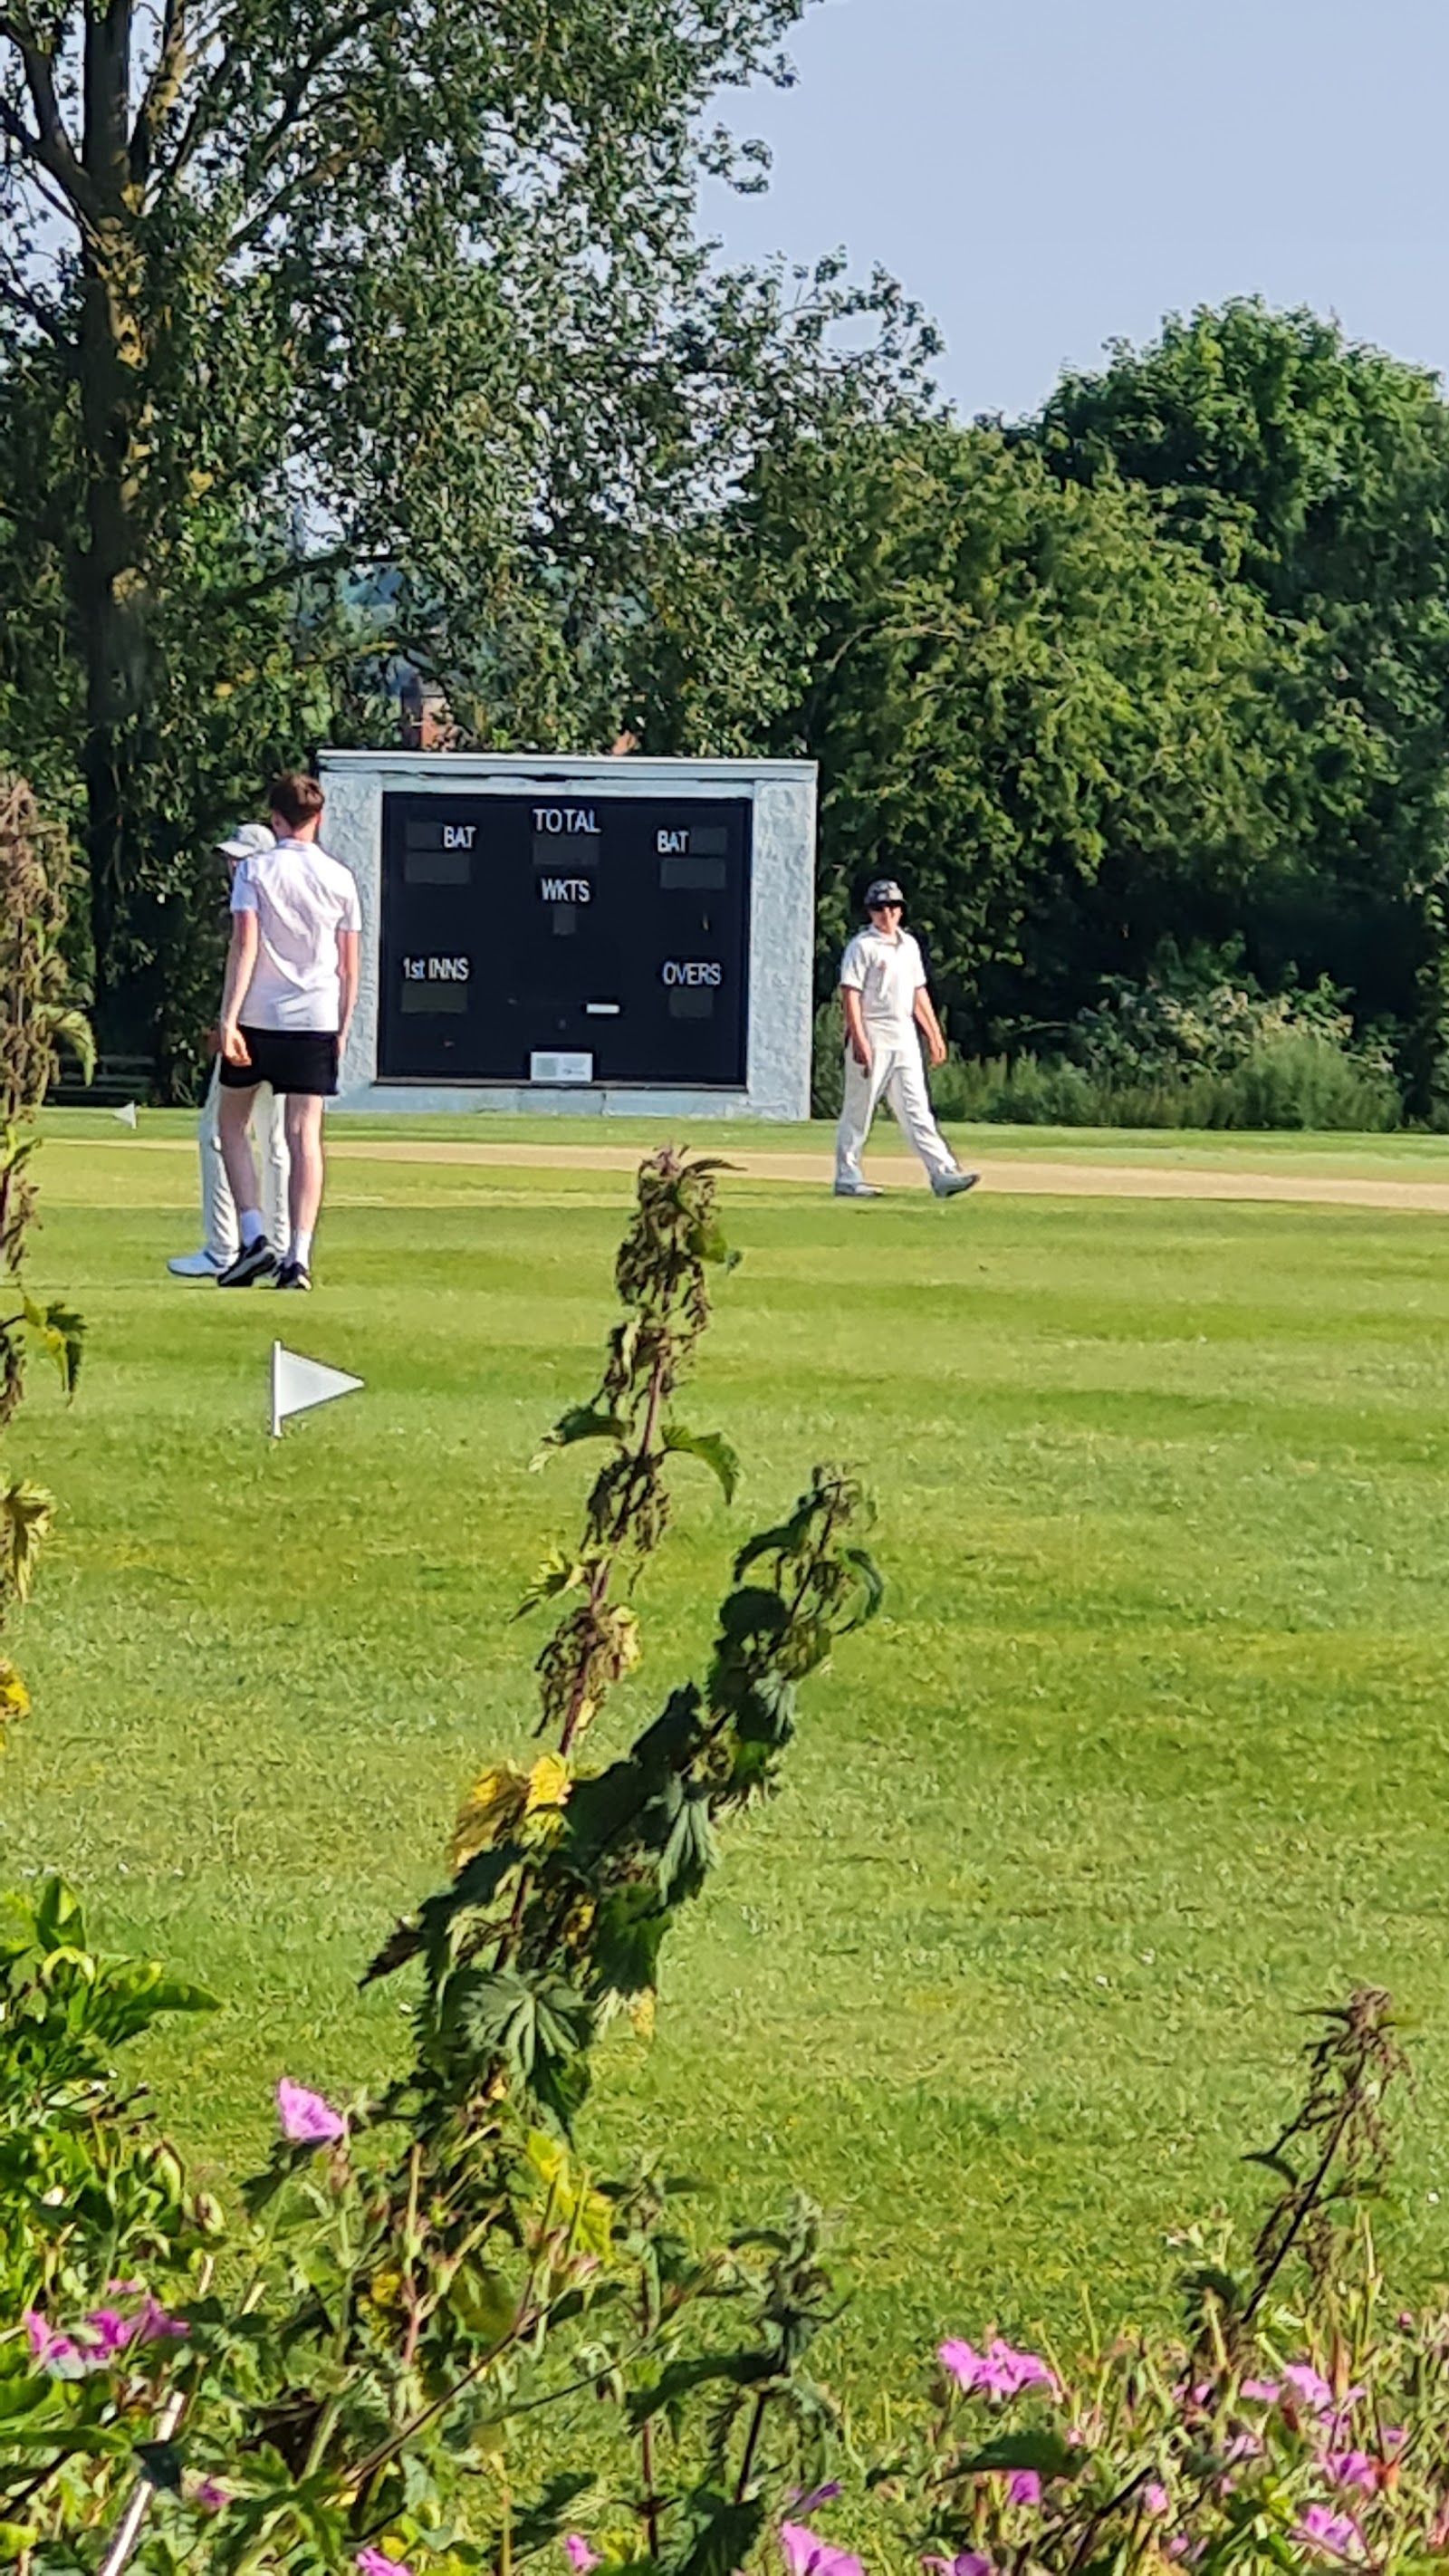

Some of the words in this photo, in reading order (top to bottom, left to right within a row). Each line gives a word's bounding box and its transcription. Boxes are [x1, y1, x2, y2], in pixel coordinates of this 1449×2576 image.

[533, 808, 601, 833] TOTAL
[444, 825, 476, 849] BAT
[657, 830, 689, 853] BAT
[542, 879, 590, 902] WKTS
[403, 957, 426, 979] 1st
[428, 957, 469, 981] INNS
[663, 961, 721, 985] OVERS
